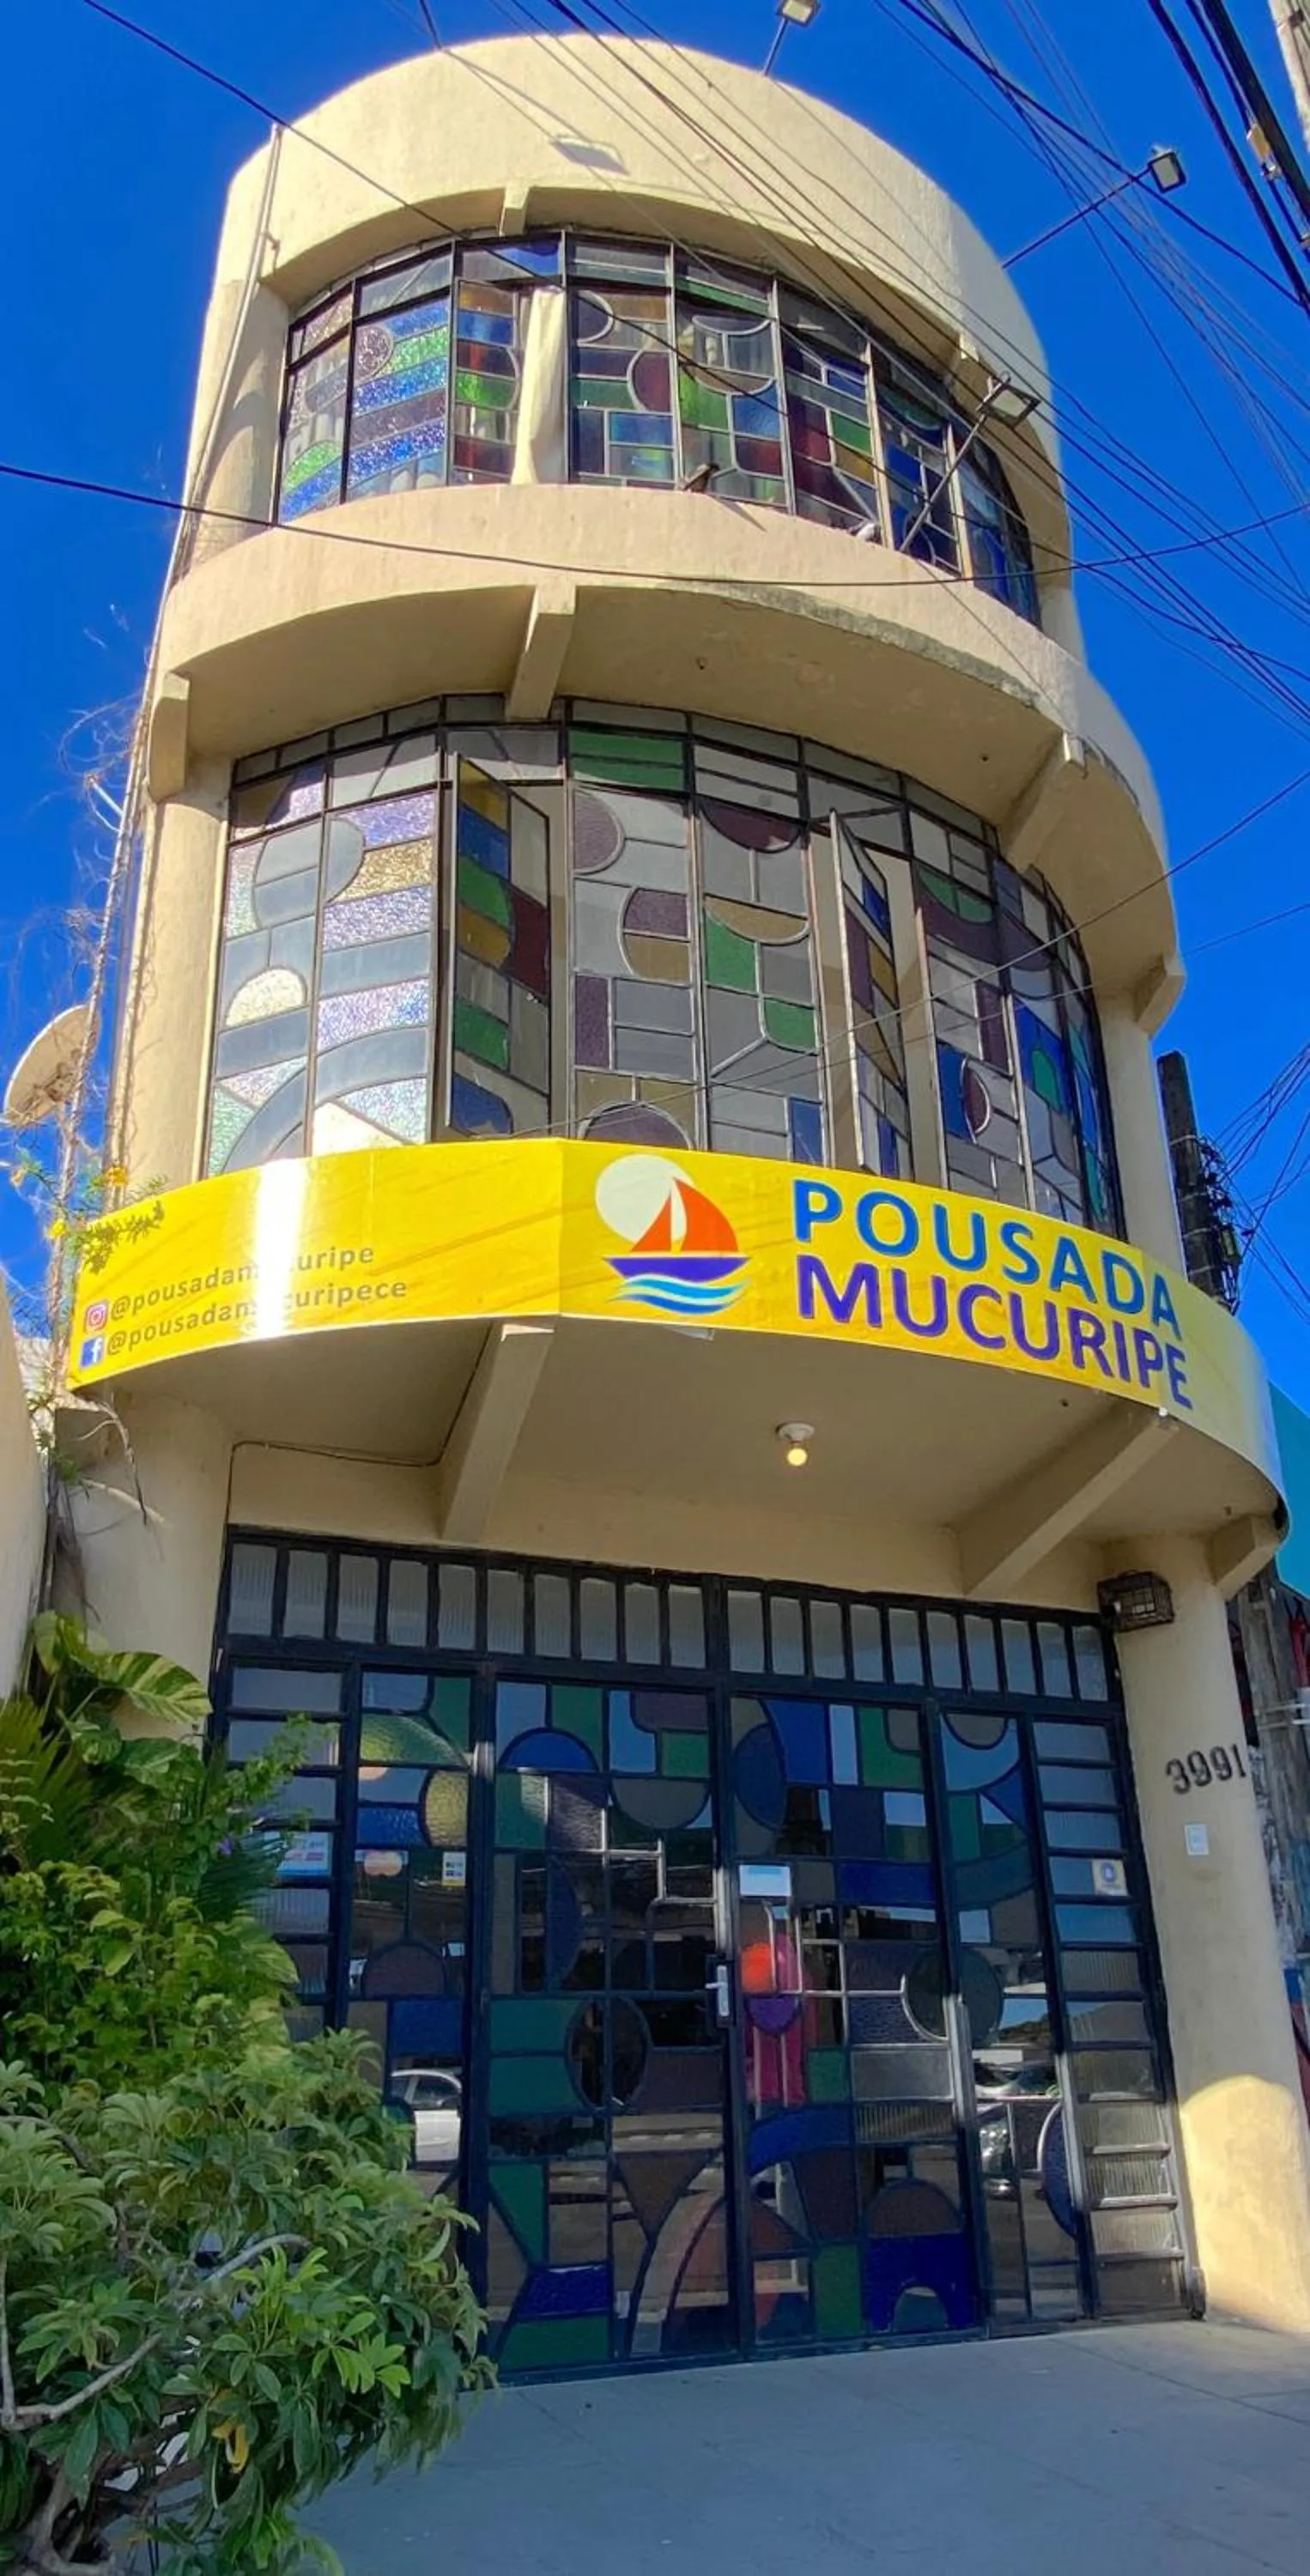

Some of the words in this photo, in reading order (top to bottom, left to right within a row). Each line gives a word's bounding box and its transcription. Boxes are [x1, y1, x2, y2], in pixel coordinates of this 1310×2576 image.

[794, 1180, 1181, 1340] POUSADA
[798, 1255, 1192, 1409] MUCURIPE
[1166, 1744, 1246, 1794] 3991
